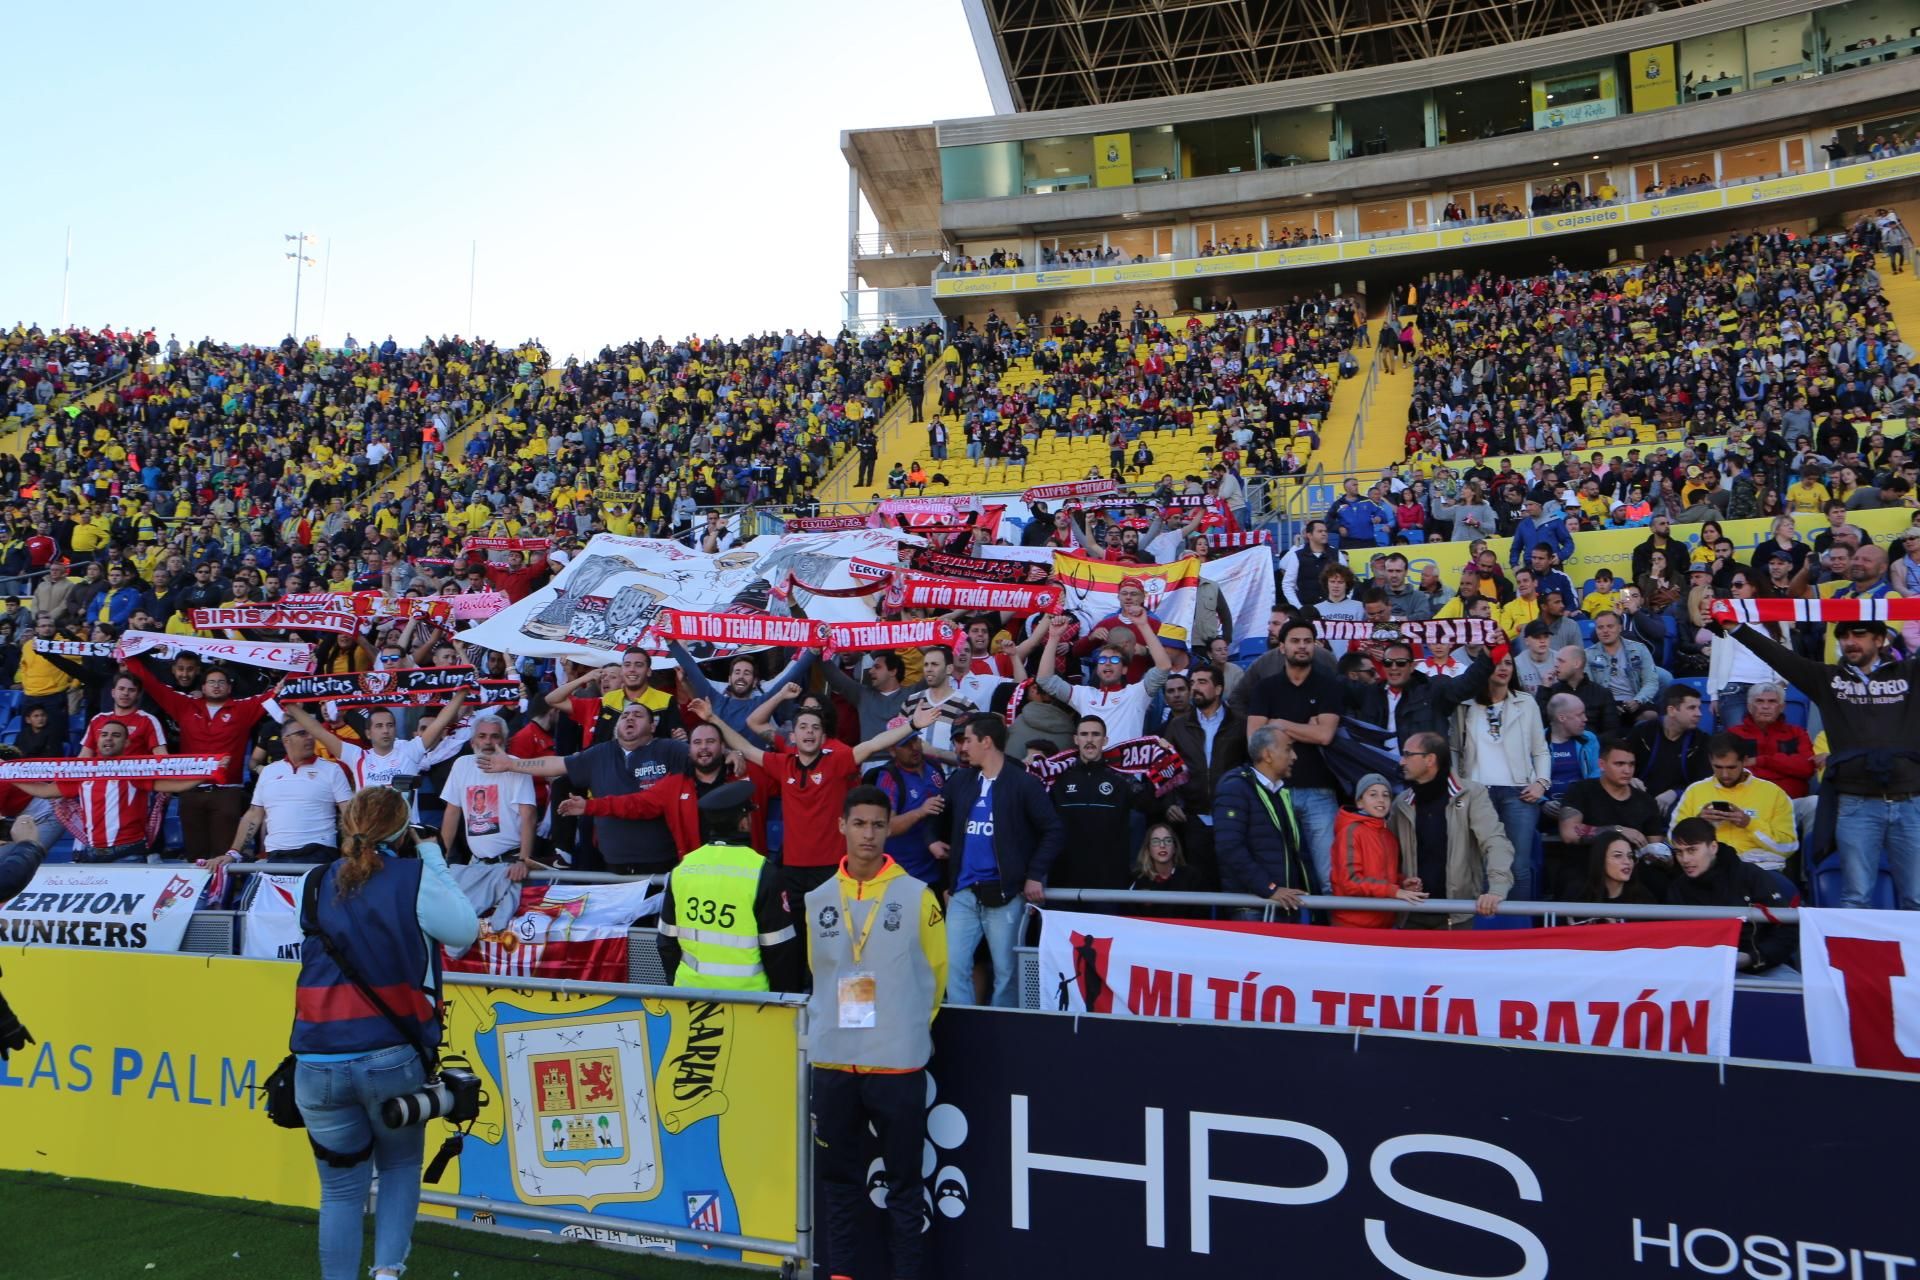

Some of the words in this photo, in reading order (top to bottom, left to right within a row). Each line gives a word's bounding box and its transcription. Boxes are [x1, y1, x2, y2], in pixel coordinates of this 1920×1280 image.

[1557, 210, 1617, 229] cajasiete
[801, 518, 838, 529] SEVILLA
[913, 586, 931, 604] MI
[931, 584, 952, 606] TÍO
[954, 585, 989, 607] TENÍA
[990, 587, 1032, 609] RAZÓN
[196, 608, 261, 625] BIRIS
[279, 609, 355, 629] NORTE
[680, 615, 698, 635] MI
[699, 613, 722, 638] TÍO
[724, 616, 762, 640] TENÍA
[765, 618, 810, 642] RAZÓN
[851, 622, 890, 647] TENÍA
[891, 620, 935, 644] RAZÓN
[248, 646, 288, 663] F.C.
[408, 669, 479, 689] Palmas
[634, 764, 667, 778] SUPPLIES
[686, 896, 737, 928] 335
[1127, 964, 1193, 1018] MI
[1208, 971, 1296, 1023] TÍO
[1312, 984, 1478, 1037] TENÍA
[1500, 988, 1710, 1055] RAZÓN
[0, 1041, 93, 1092] LAS
[112, 1046, 269, 1112] PALM
[1011, 1094, 1549, 1280] HPS
